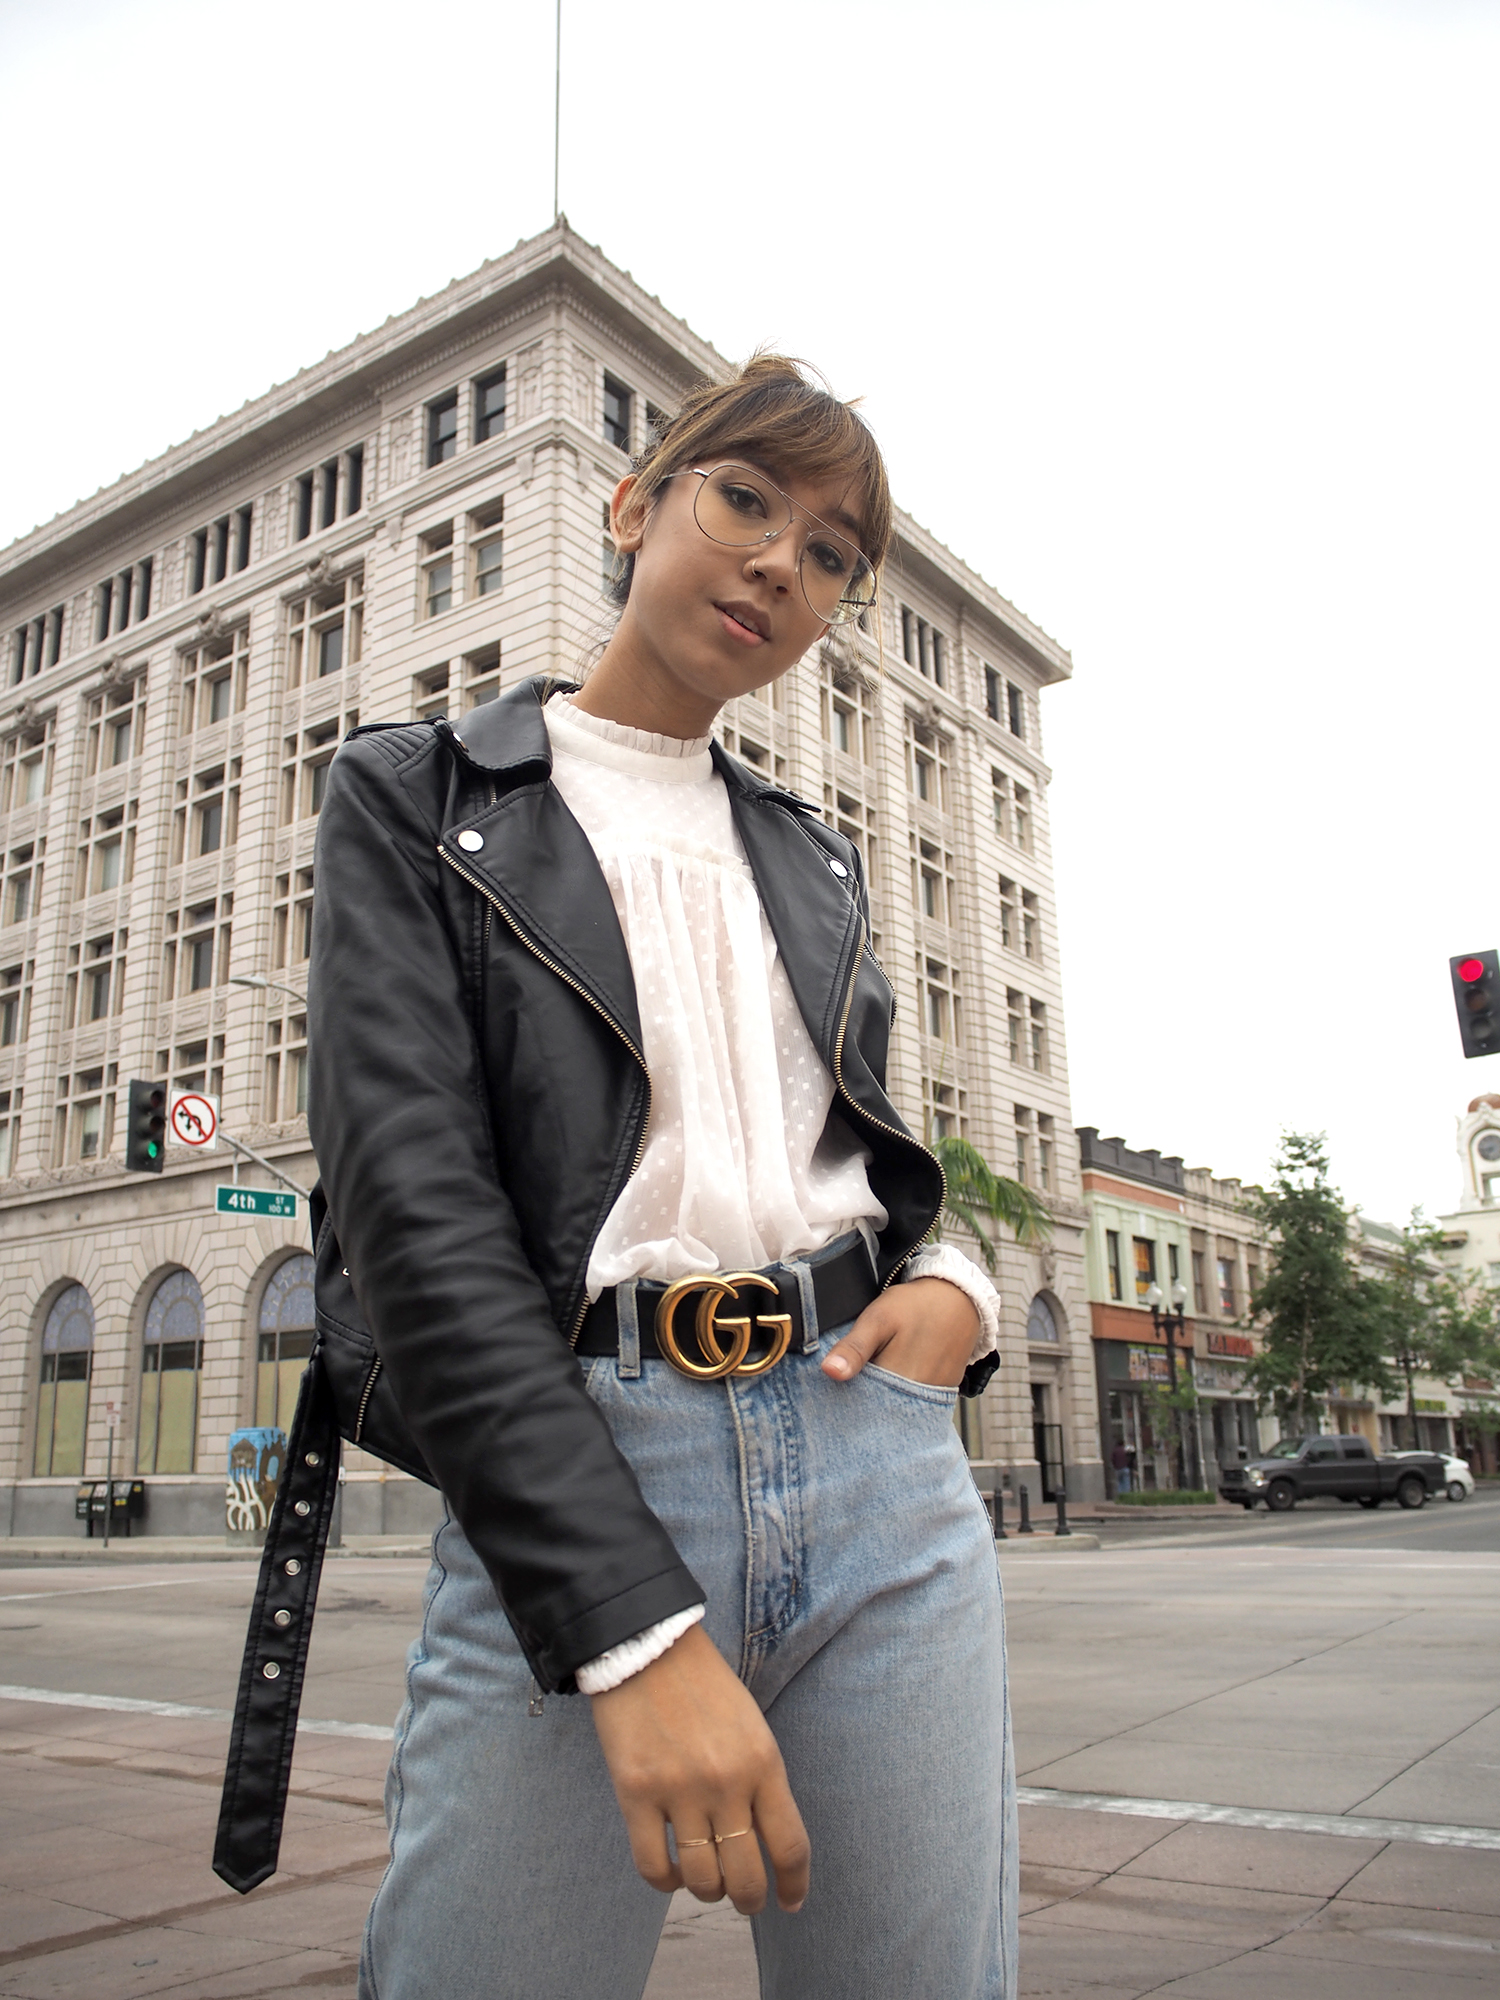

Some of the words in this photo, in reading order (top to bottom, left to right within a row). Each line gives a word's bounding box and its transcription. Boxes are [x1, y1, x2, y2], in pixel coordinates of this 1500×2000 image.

[228, 1192, 256, 1210] 4th
[275, 1196, 284, 1204] ST
[268, 1204, 281, 1213] 100
[284, 1206, 290, 1214] W
